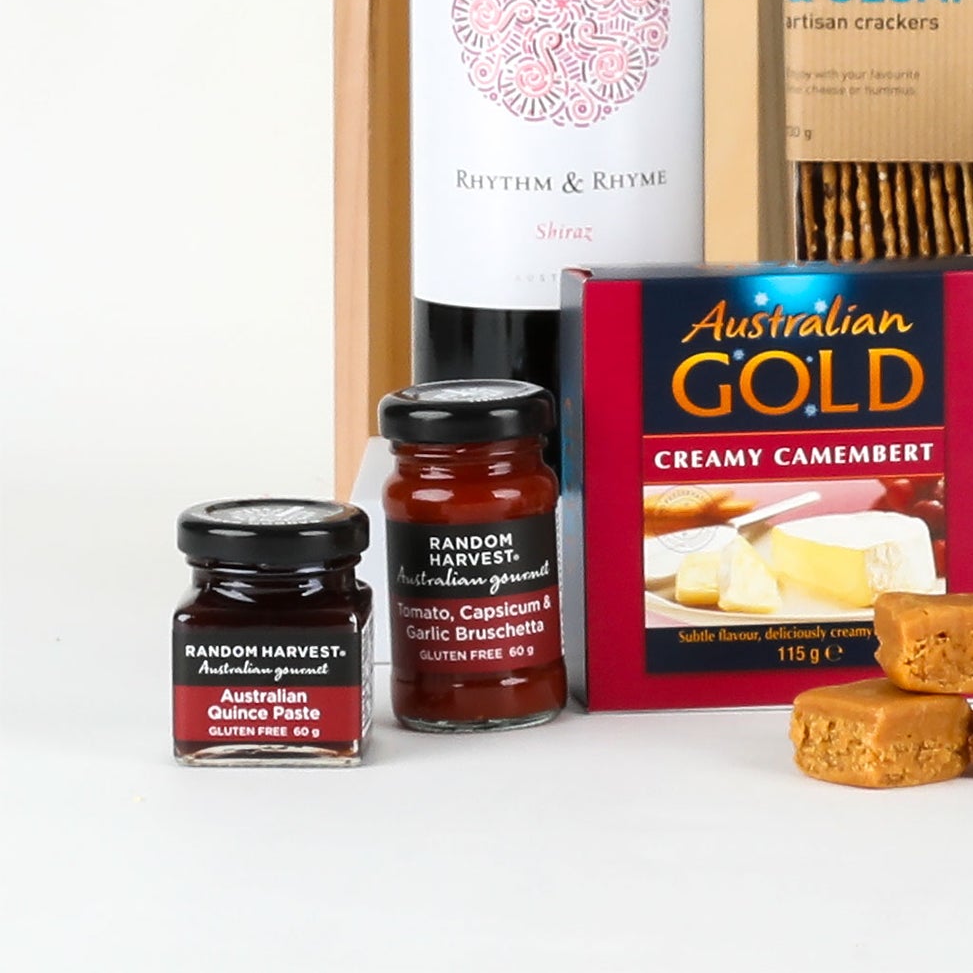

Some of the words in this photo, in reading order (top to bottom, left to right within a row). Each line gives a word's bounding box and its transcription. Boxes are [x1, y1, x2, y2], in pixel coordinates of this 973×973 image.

[786, 13, 848, 30] artisan
[855, 13, 939, 31] crackers
[562, 172, 583, 194] &
[536, 220, 593, 242] Shiraz
[681, 294, 914, 343] Australian
[671, 347, 925, 418] GOLD
[654, 448, 763, 470] CREAMY
[774, 442, 934, 466] CAMEMBERT
[429, 533, 513, 550] RANDOM
[397, 565, 487, 587] Australian
[489, 560, 550, 594] gourmet
[397, 602, 454, 622] Tomato,
[459, 600, 540, 621] Capsicum
[543, 595, 551, 609] &
[406, 625, 450, 641] Garlic
[455, 619, 544, 641] Bruschetta
[678, 630, 715, 643] Subtle
[719, 628, 761, 644] flavour,
[765, 626, 826, 641] deliciously
[830, 627, 871, 641] creamy
[185, 645, 258, 658] RANDOM
[419, 648, 467, 661] GLUTEN
[470, 648, 503, 660] FREE
[509, 645, 524, 657] 60
[526, 646, 534, 656] g
[778, 646, 805, 661] 115
[810, 649, 820, 664] g
[198, 660, 273, 675] Australian
[274, 663, 330, 682] gourmet
[220, 689, 307, 704] Australian
[207, 706, 268, 721] Quince
[273, 706, 321, 721] Paste
[208, 726, 255, 736] GLUTEN
[258, 726, 288, 736] FREE
[293, 726, 309, 737] 60
[312, 728, 320, 738] g
